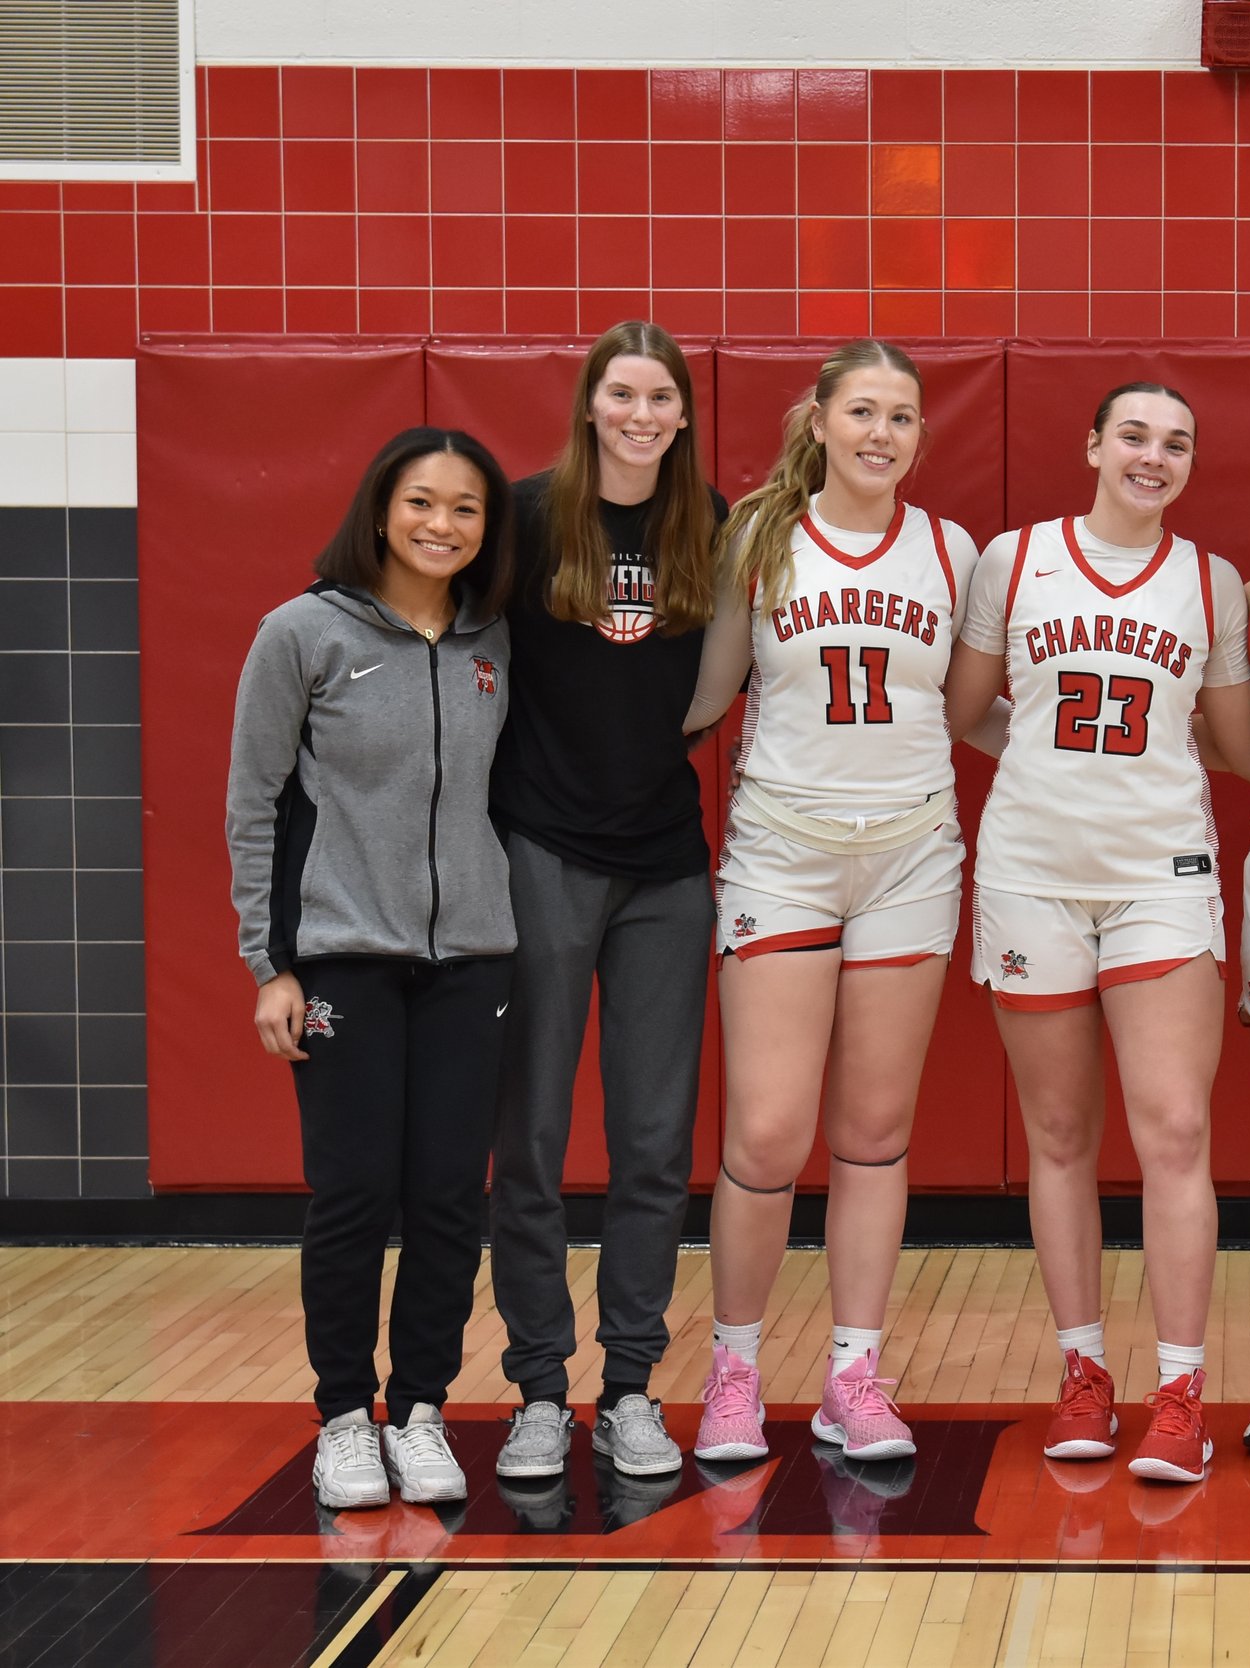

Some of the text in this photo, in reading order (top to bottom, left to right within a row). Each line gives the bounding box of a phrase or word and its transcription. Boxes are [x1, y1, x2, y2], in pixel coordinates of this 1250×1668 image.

[772, 588, 938, 646] CHARGERS
[1025, 615, 1192, 679] CHARGERS
[820, 646, 893, 725] 11
[1054, 671, 1154, 757] 23
